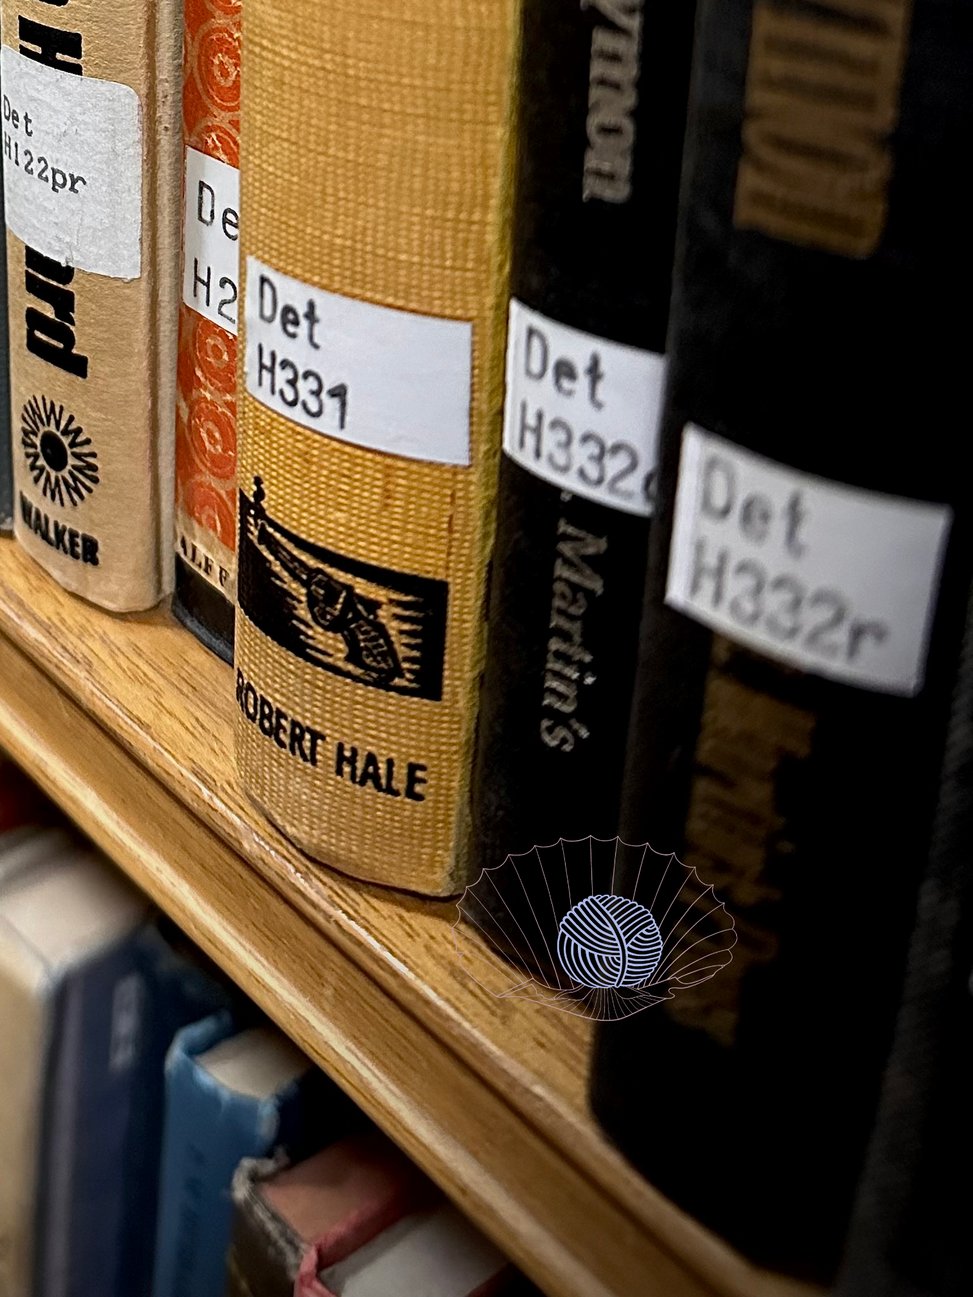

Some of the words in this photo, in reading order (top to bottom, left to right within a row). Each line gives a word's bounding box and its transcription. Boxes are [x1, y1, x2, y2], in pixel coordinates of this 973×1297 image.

[3, 94, 34, 137] Det
[3, 130, 87, 194] H122pr
[196, 179, 239, 242] De
[193, 257, 239, 324] H2
[257, 273, 322, 350] Det
[255, 342, 350, 431] H331
[523, 324, 607, 411] Det
[19, 490, 101, 567] WALKER
[699, 452, 811, 562] Det
[539, 516, 609, 754] Martin's
[687, 534, 895, 664] H332r
[235, 666, 326, 766] ROBERT
[335, 741, 429, 802] HALE
